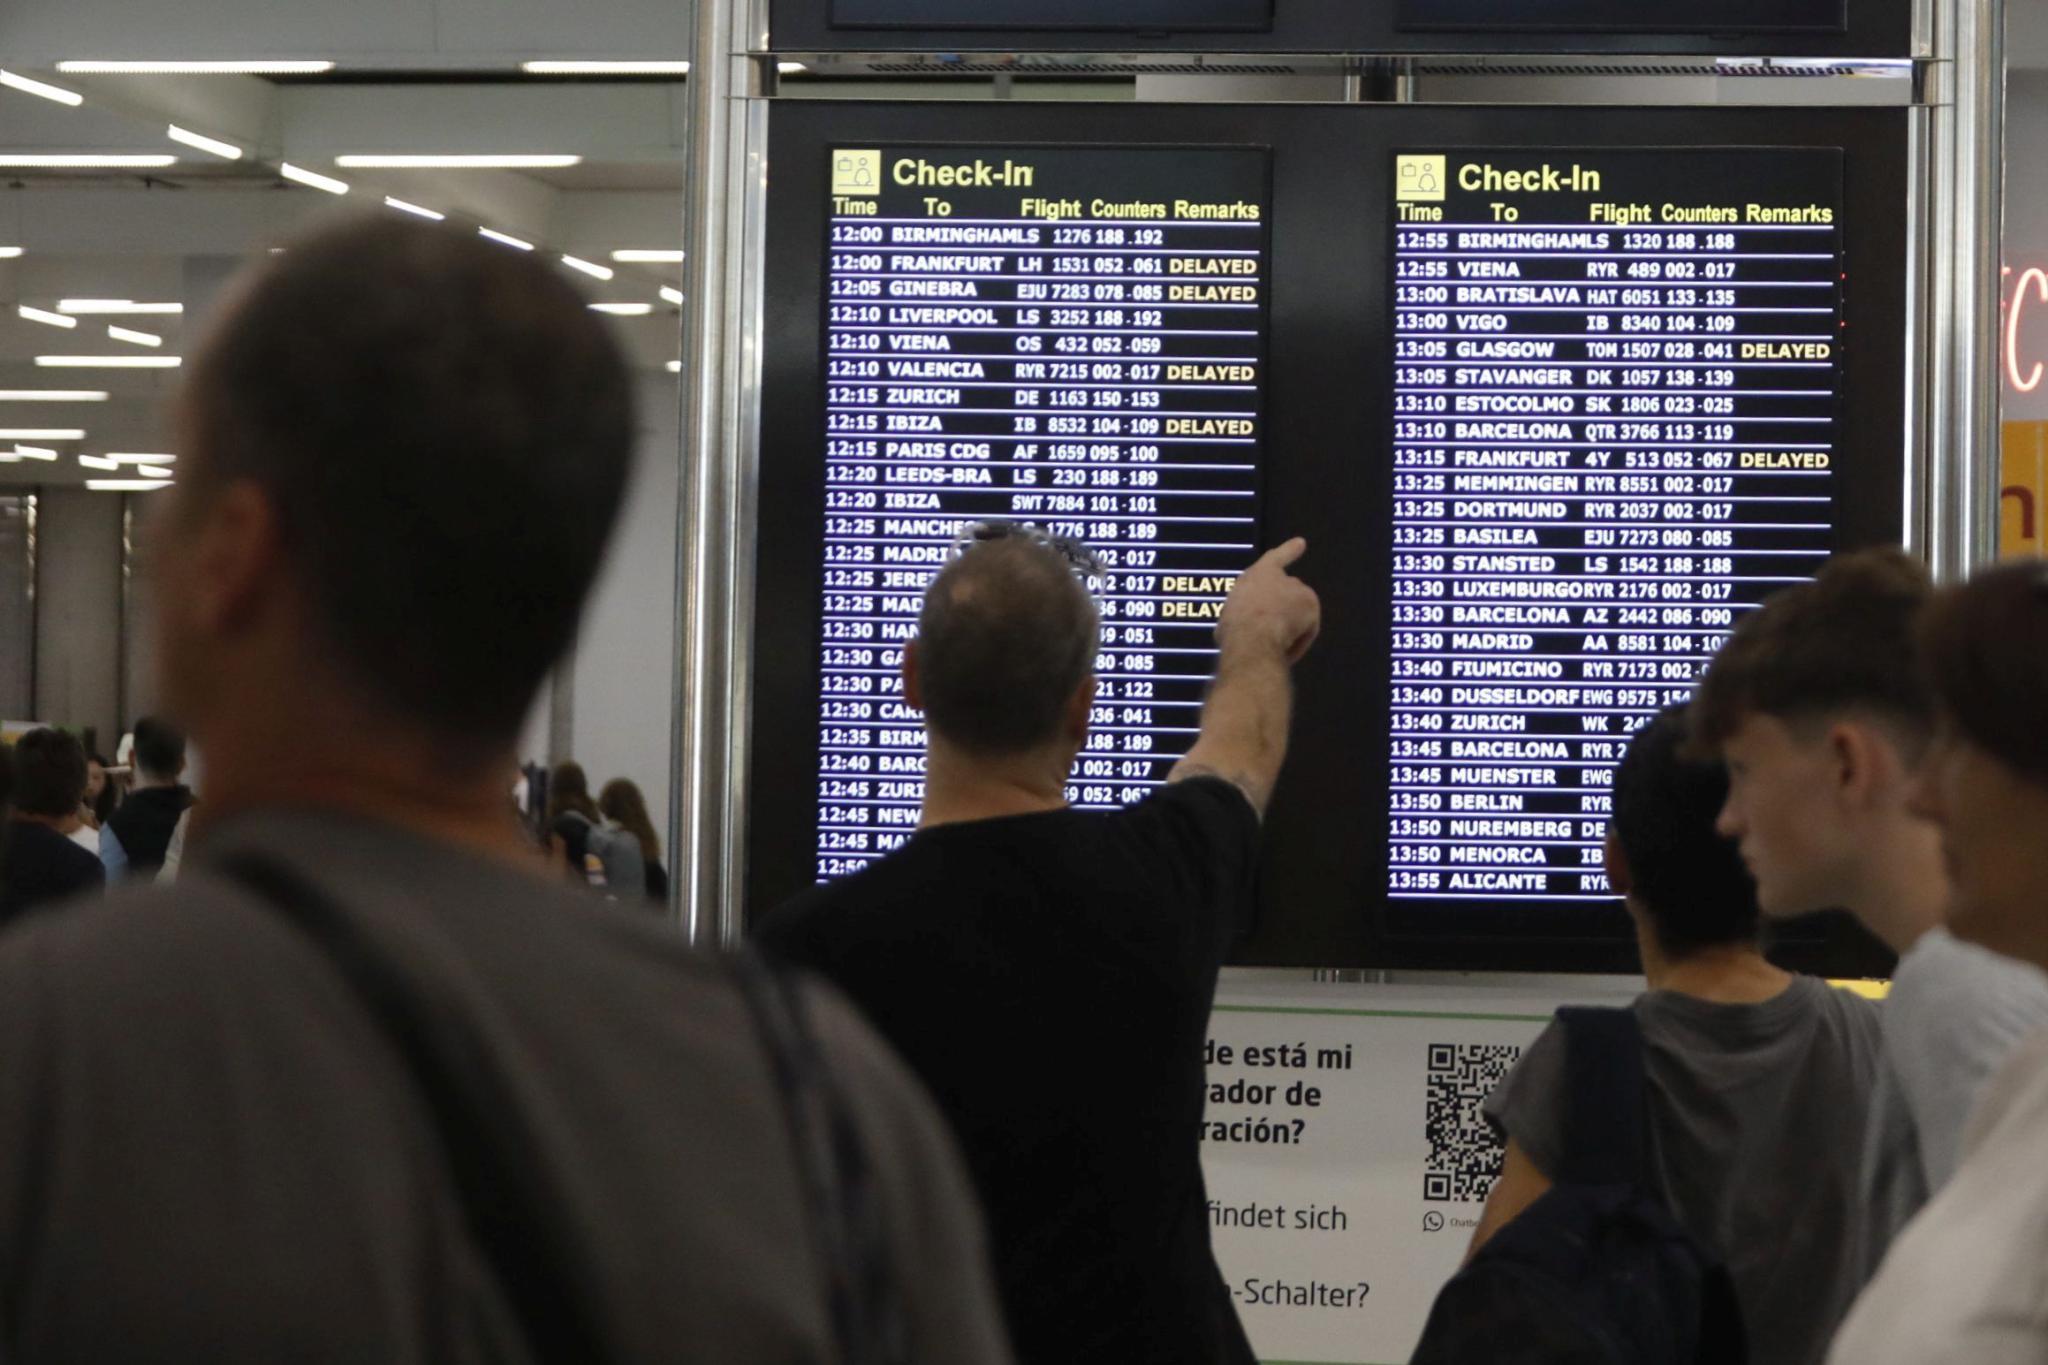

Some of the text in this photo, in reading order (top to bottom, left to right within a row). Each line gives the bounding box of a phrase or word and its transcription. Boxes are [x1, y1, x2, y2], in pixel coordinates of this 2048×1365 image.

[892, 158, 1033, 187] Check-In
[1458, 163, 1600, 191] Check-In
[832, 196, 1260, 221] Time To Flight Counters Remarks
[1396, 202, 1833, 225] Time To Flight Counters Remarks
[832, 225, 883, 242] 12:00
[1397, 232, 1448, 248] 12:55
[831, 254, 1257, 274] 12:00 FRANKFURT LH DELAYED
[1396, 260, 1661, 278] 12:55 VIENA RYR 489
[830, 279, 1256, 301] 12:05 GINEBRA EJU 7283 DELAYED
[1396, 286, 1618, 304] 13:00 BRATISLAVA HAT
[830, 305, 1040, 325] 12:10 LIVERPOOL LS
[1396, 312, 1661, 331] 13:00 VIGO IB 8340
[830, 333, 1088, 352] 12:10 VIENA OS 432
[1396, 340, 1830, 359] 13:05 GLASGOW TOM DELAYED
[829, 360, 1255, 381] 12:10 VALENCIA RYR DELAYED
[1395, 367, 1612, 385] 13:05 STAVANGER DK
[828, 387, 1088, 406] 12:15 ZURICH DE 1163
[1395, 395, 1611, 412] 13:10 ESTOCOLMO SK
[828, 413, 1253, 435] 12:15 IBIZA IB DELAYED
[1395, 422, 1616, 440] 13:10 BARCELONA QTR
[827, 440, 1086, 460] 12:15 PARIS CDG AF 1659
[1394, 448, 1829, 468] 13:15 FRANKFURT 4Y 513 DELAYED
[826, 465, 1036, 484] 12:20 LEEDS-BRA LS
[1394, 474, 1616, 492] 13:25 MEMMINGEN RYR
[826, 491, 1043, 510] 12:20 IBIZA SWT
[1394, 500, 1567, 518] 13:25 DORTMUND
[825, 518, 875, 534] 12:25
[1393, 527, 1615, 545] 13:25 BASILEA EJU
[825, 544, 875, 561] 12:25
[1393, 554, 1658, 572] 13:30 STANSTED LS 1542
[824, 569, 874, 586] 12:25
[1393, 580, 1444, 597] 13:30
[823, 595, 873, 612] 12:25
[1392, 605, 1608, 624] 13:30 BARCELONA AZ
[823, 621, 873, 638] 12:30
[1392, 632, 1608, 650] 13:30 MADRID AA
[822, 648, 873, 665] 12:30
[1392, 659, 1657, 678] 13:40 FIUMICINO 7173
[822, 675, 872, 692] 12:30
[1391, 687, 1613, 705] 13:40 DUSSELDORF EWG
[821, 701, 871, 718] 12:30
[1391, 713, 1608, 731] 13:40 ZURICH WK
[820, 728, 870, 745] 12:35
[1391, 740, 1612, 758] 13:45 BARCELONA RYR
[820, 754, 870, 771] 12:40
[1390, 766, 1612, 785] 13:45 MUENSTER EWG
[819, 780, 869, 797] 12:45
[1390, 792, 1523, 810] 13:50 BERLIN
[819, 806, 868, 823] 12:45
[1390, 819, 1605, 837] 13:50 NUREMBERG DE
[818, 832, 868, 849] 12:45
[1389, 845, 1603, 864] 13:50 MENORCA IB
[1389, 871, 1546, 890] 13:55 ALICANTE
[1243, 1042, 1307, 1068] está
[1317, 1044, 1352, 1069] mi
[1285, 1080, 1322, 1107] de
[1294, 1204, 1348, 1231] sich
